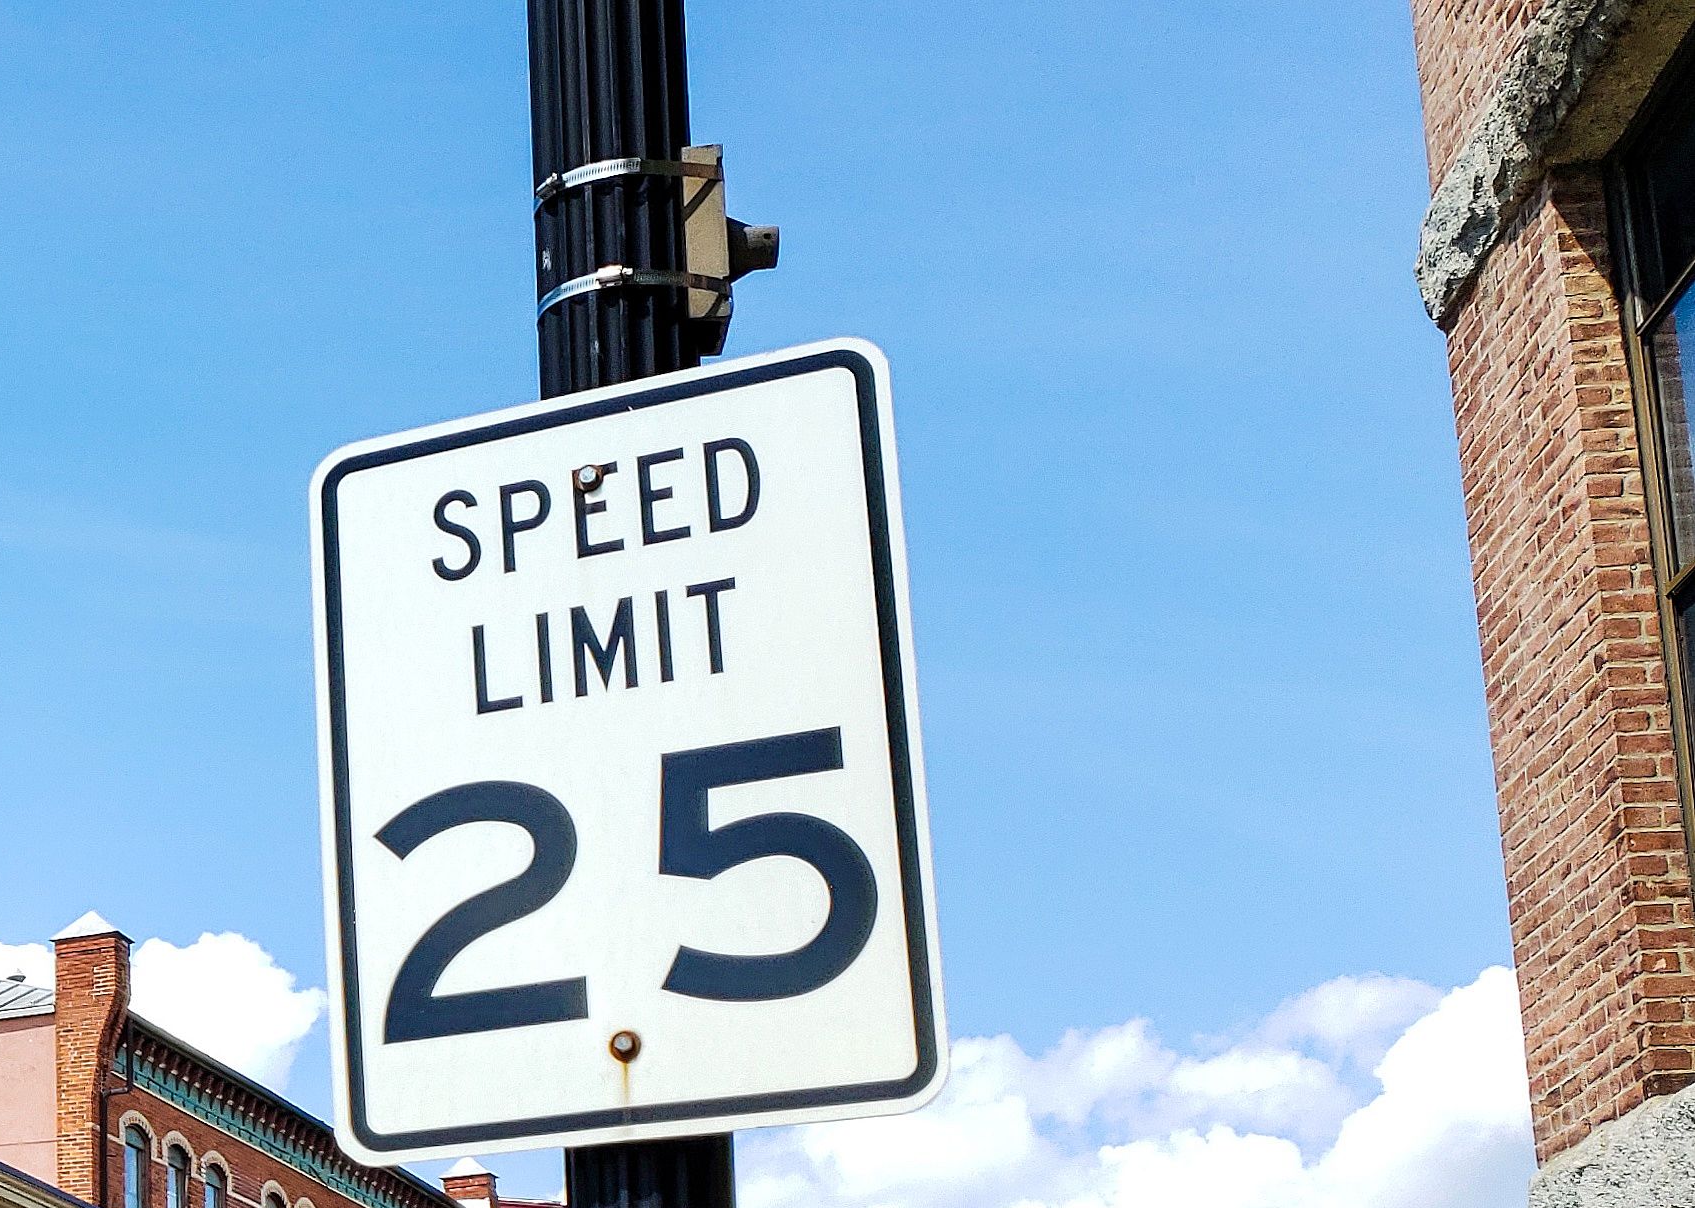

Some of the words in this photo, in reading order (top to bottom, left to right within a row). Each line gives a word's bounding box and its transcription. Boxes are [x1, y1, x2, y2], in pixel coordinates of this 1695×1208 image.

[432, 437, 761, 581] SPEED
[472, 577, 736, 715] LIMIT
[374, 726, 878, 1045] 25
